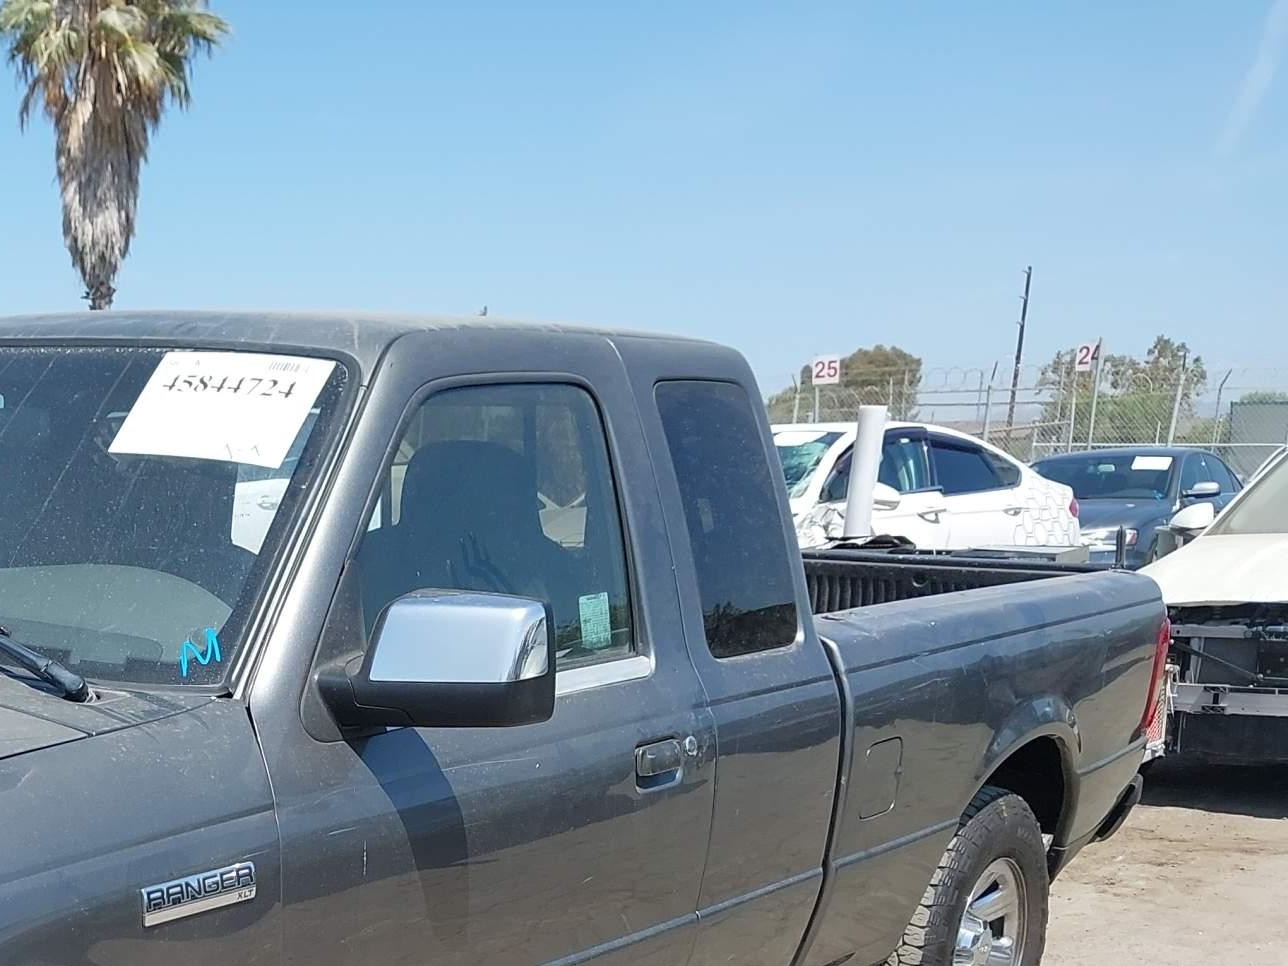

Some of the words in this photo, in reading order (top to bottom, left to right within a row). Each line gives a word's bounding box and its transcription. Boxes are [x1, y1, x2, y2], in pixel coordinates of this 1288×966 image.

[814, 361, 838, 378] 25
[162, 374, 296, 398] 45844724
[146, 867, 253, 912] RANGER
[237, 889, 253, 900] XLT
